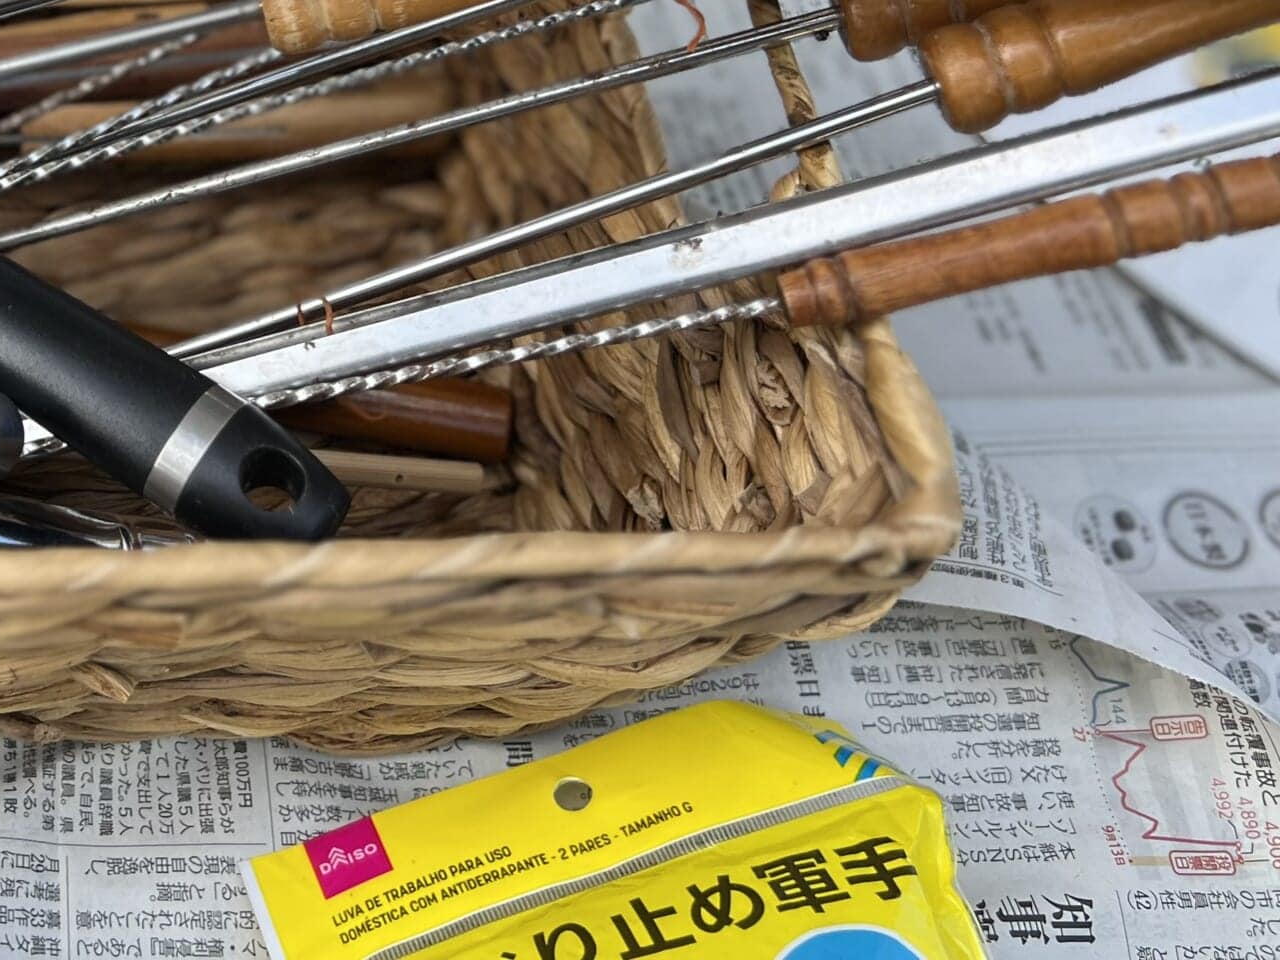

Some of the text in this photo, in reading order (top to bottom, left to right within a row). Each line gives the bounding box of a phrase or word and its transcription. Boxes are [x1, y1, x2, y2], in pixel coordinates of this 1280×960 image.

[1109, 697, 1127, 724] 144
[1155, 719, 1204, 737] 告示日
[951, 739, 1062, 760] 投稿を分析した。
[1072, 727, 1085, 742] 27
[1232, 696, 1280, 806] の転覆事故と
[117, 742, 133, 835] かった。5人
[213, 739, 234, 834] 太郎知事らが
[233, 741, 252, 808] 費100万円
[1210, 777, 1231, 820] 4,992
[1238, 796, 1260, 840] 4,890
[319, 843, 377, 875] DAISO
[1102, 825, 1125, 866] 9月13日
[1176, 855, 1230, 870] 投開票日
[332, 846, 512, 927] LUVA DE TRABALHO PARA USO
[340, 906, 409, 944] DOMÉSTICA
[411, 893, 439, 913] COM
[441, 853, 549, 901] ANTIDERRAPANTE
[558, 847, 569, 860] 2
[570, 833, 612, 857] PARES
[619, 804, 681, 838] TAMANHO
[682, 801, 693, 814] G
[76, 909, 255, 930] 的に認定されたことを意
[501, 836, 919, 960] り止め軍手
